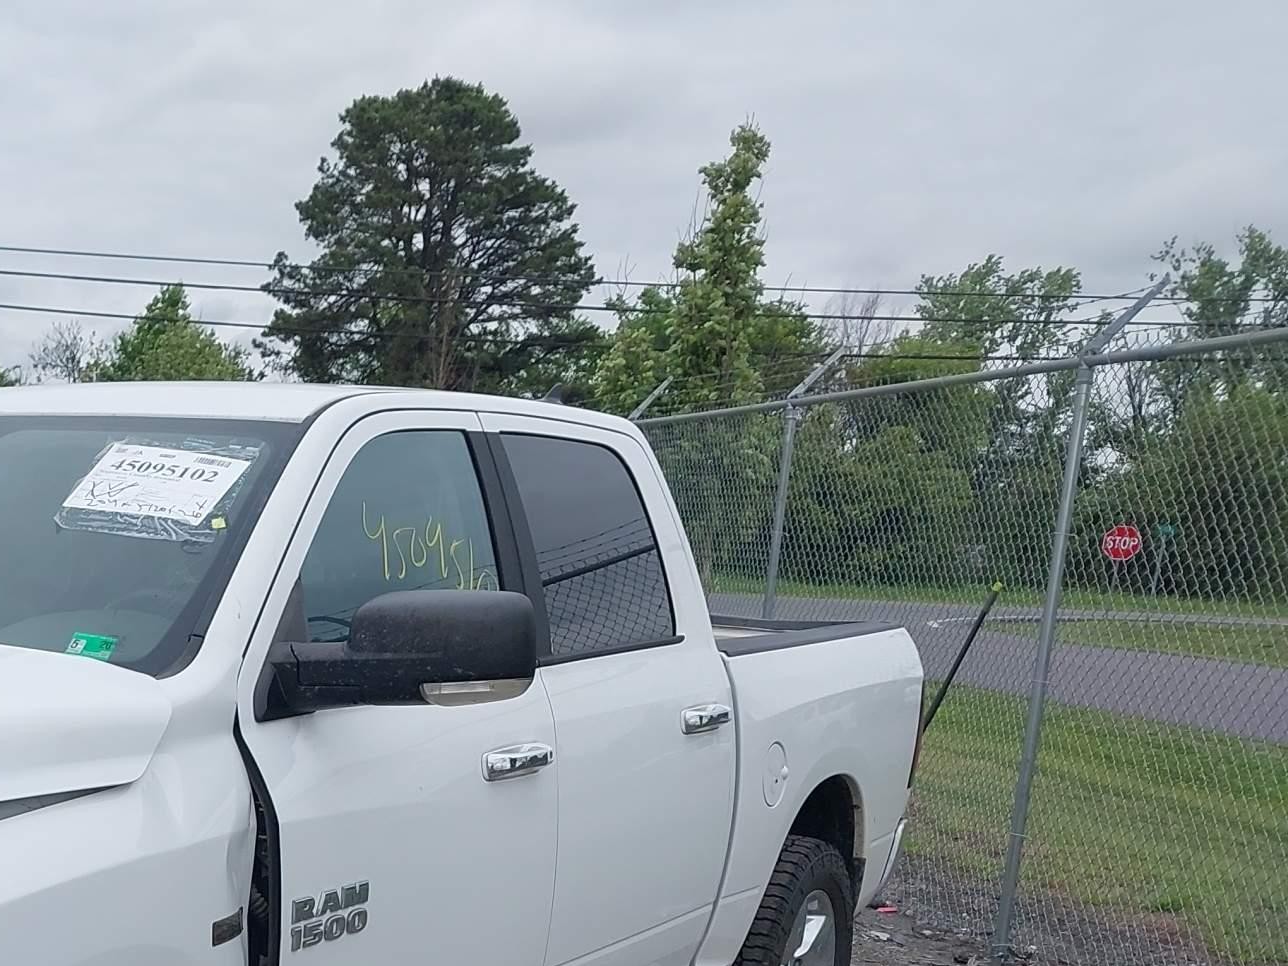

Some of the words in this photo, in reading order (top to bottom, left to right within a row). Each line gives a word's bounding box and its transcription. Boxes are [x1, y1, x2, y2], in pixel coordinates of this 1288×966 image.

[110, 459, 218, 483] 45095102
[1107, 536, 1138, 550] STOP
[292, 880, 369, 924] RAM
[291, 908, 368, 952] 1500
